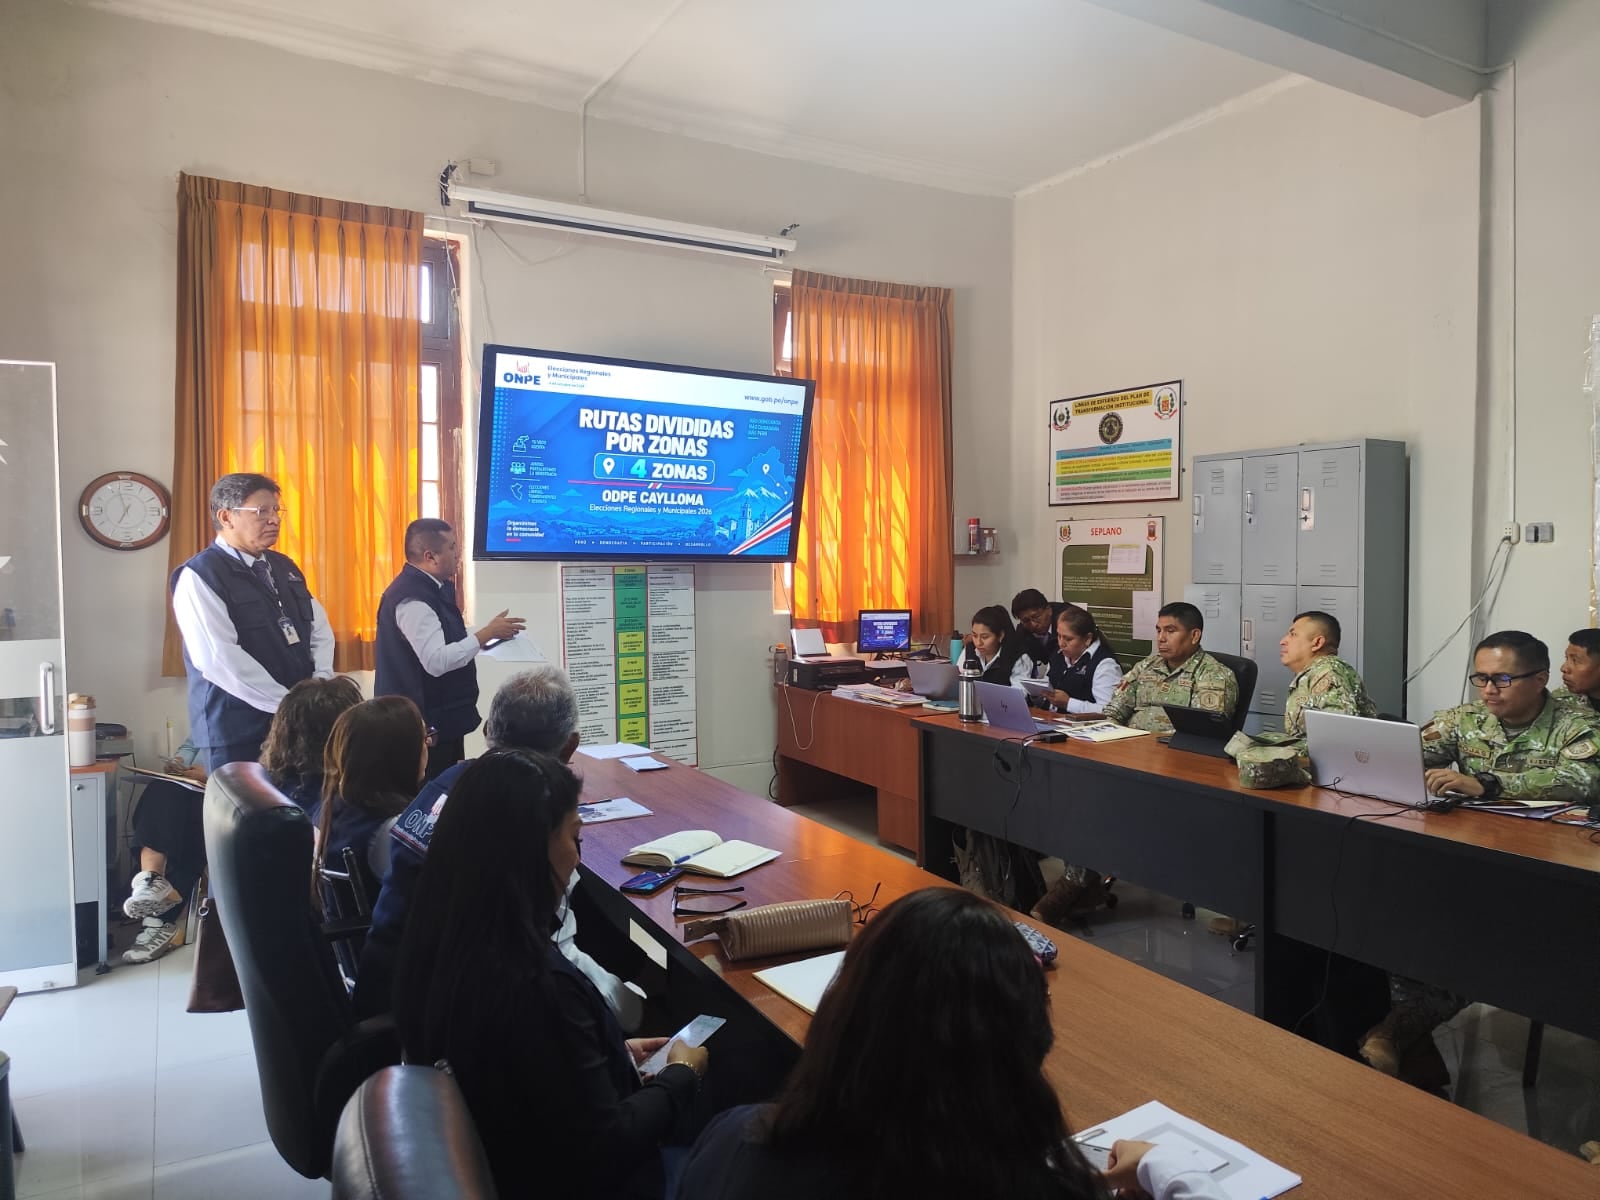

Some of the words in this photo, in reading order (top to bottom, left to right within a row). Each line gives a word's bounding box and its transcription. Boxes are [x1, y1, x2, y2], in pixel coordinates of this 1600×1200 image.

[547, 365, 579, 374] Elecciones
[580, 368, 611, 377] Regionales
[552, 372, 588, 381] Municipales
[503, 372, 541, 385] ONPE
[744, 394, 799, 406] www.gob.pe/onpe
[579, 408, 643, 433] RUTAS
[645, 413, 735, 440] DIVIDIDAS
[605, 431, 645, 454] POR
[648, 434, 708, 458] ZONAS
[629, 458, 647, 479] 4
[652, 462, 708, 481] ZONAS
[602, 489, 638, 503] ODPE
[640, 491, 704, 506] CAYLLOMA
[589, 503, 622, 513] Elecciones
[623, 505, 657, 515] Regionales
[663, 505, 698, 515] Municipales
[698, 506, 713, 515] 2026
[1090, 527, 1122, 536] SEPLANO
[404, 809, 434, 839] ONP
